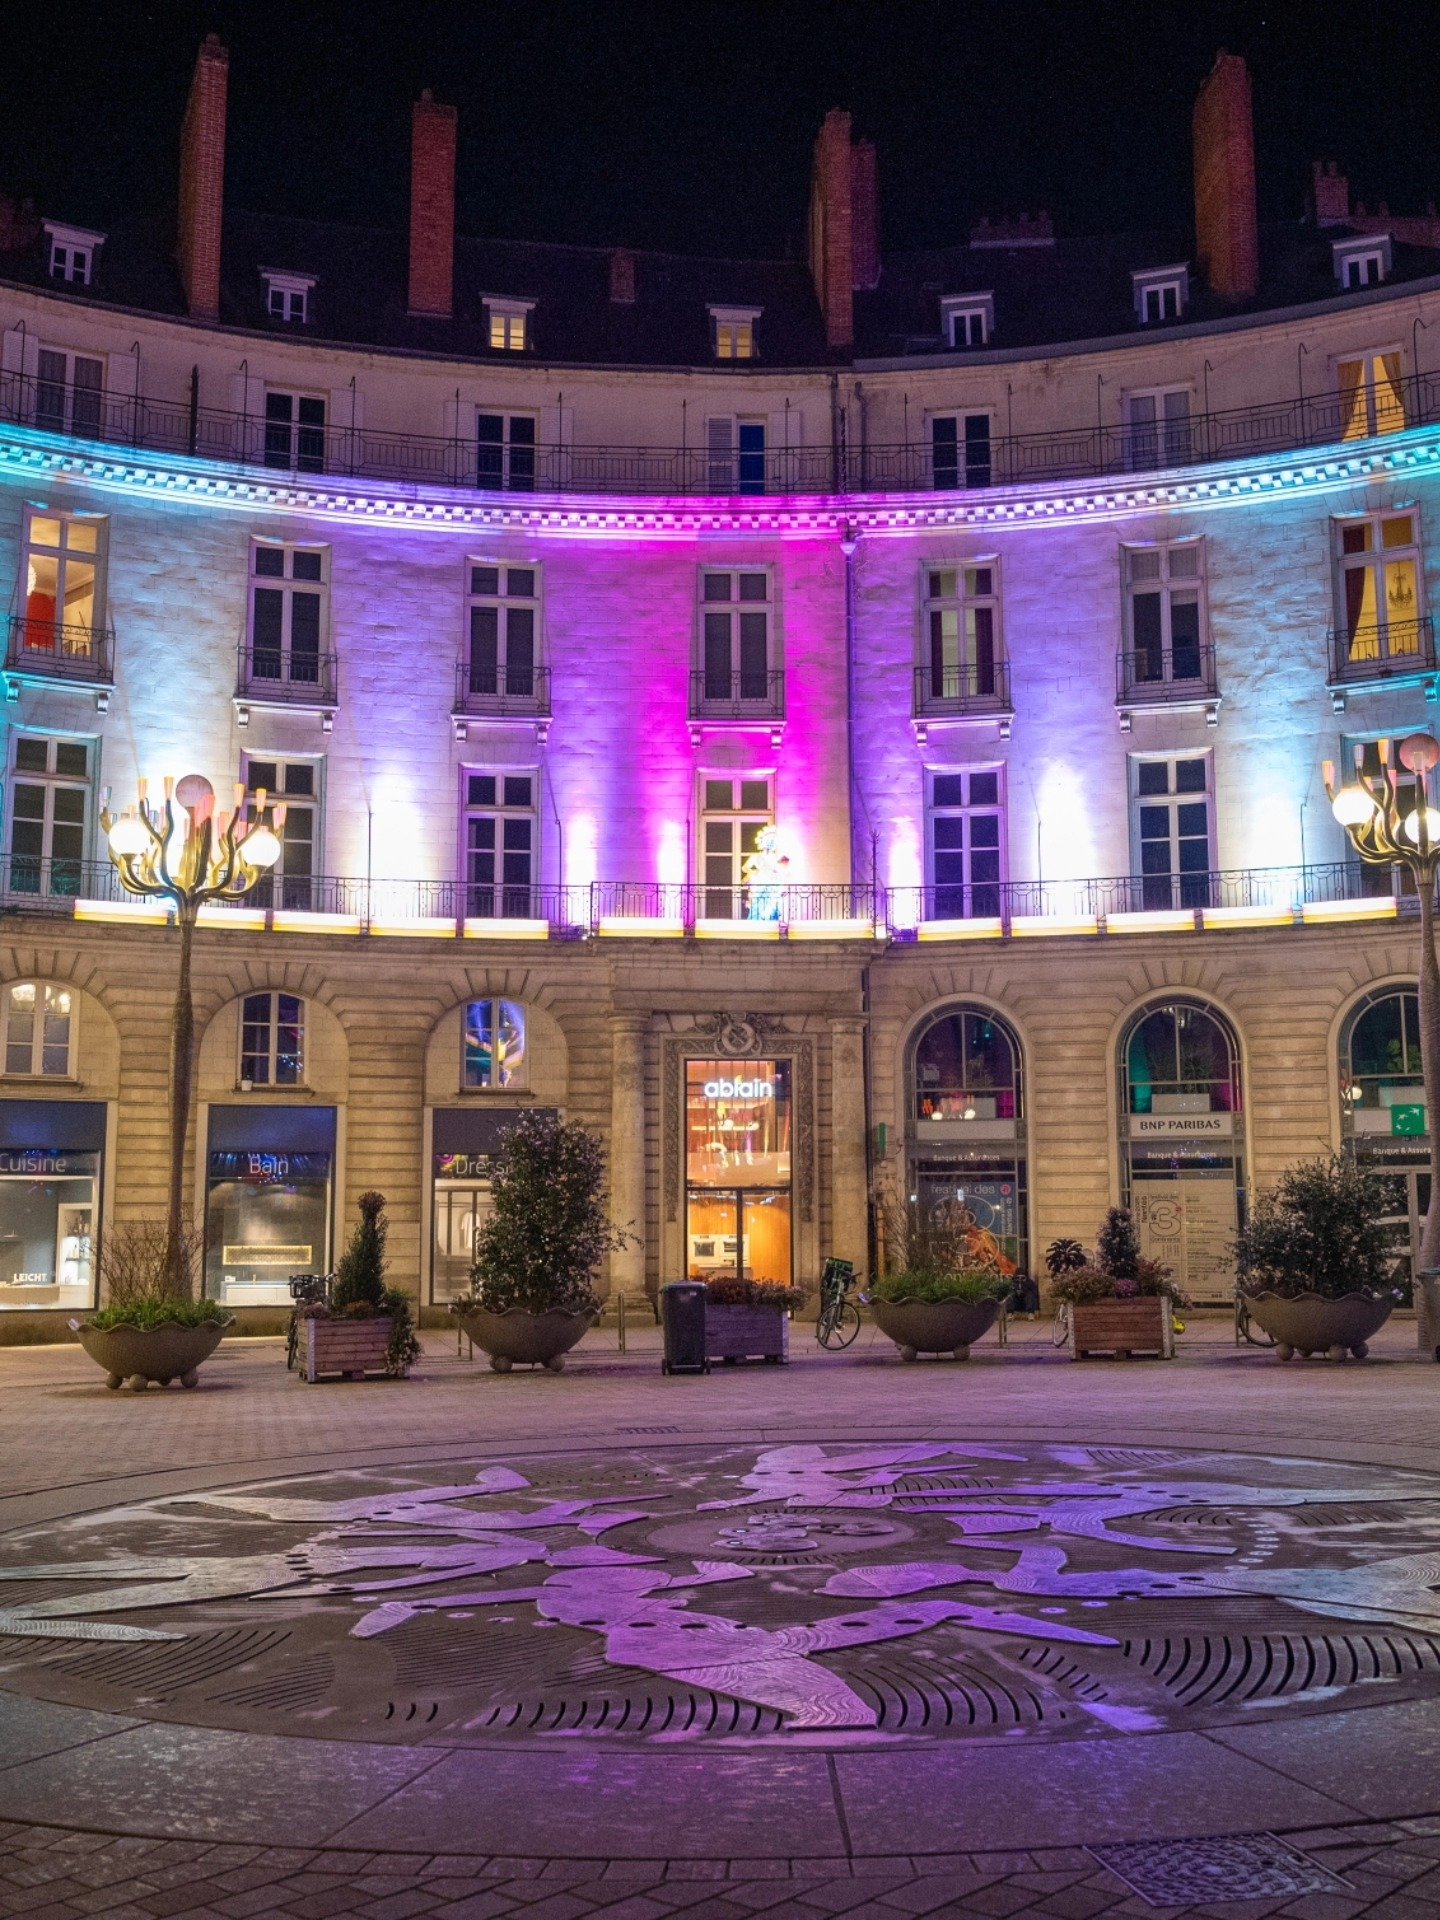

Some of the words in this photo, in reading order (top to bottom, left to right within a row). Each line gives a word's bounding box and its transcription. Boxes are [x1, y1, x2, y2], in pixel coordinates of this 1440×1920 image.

[1140, 1121, 1165, 1131] BNP
[1169, 1120, 1221, 1130] PARIBAS
[1147, 1151, 1172, 1160] Banque
[1373, 1147, 1399, 1155] Banque
[0, 1153, 67, 1173] Cuisine
[249, 1155, 288, 1174] Bain
[456, 1158, 509, 1175] Dressi
[930, 1184, 972, 1195] festial
[974, 1184, 996, 1195] des
[13, 1273, 48, 1282] LEICHT
